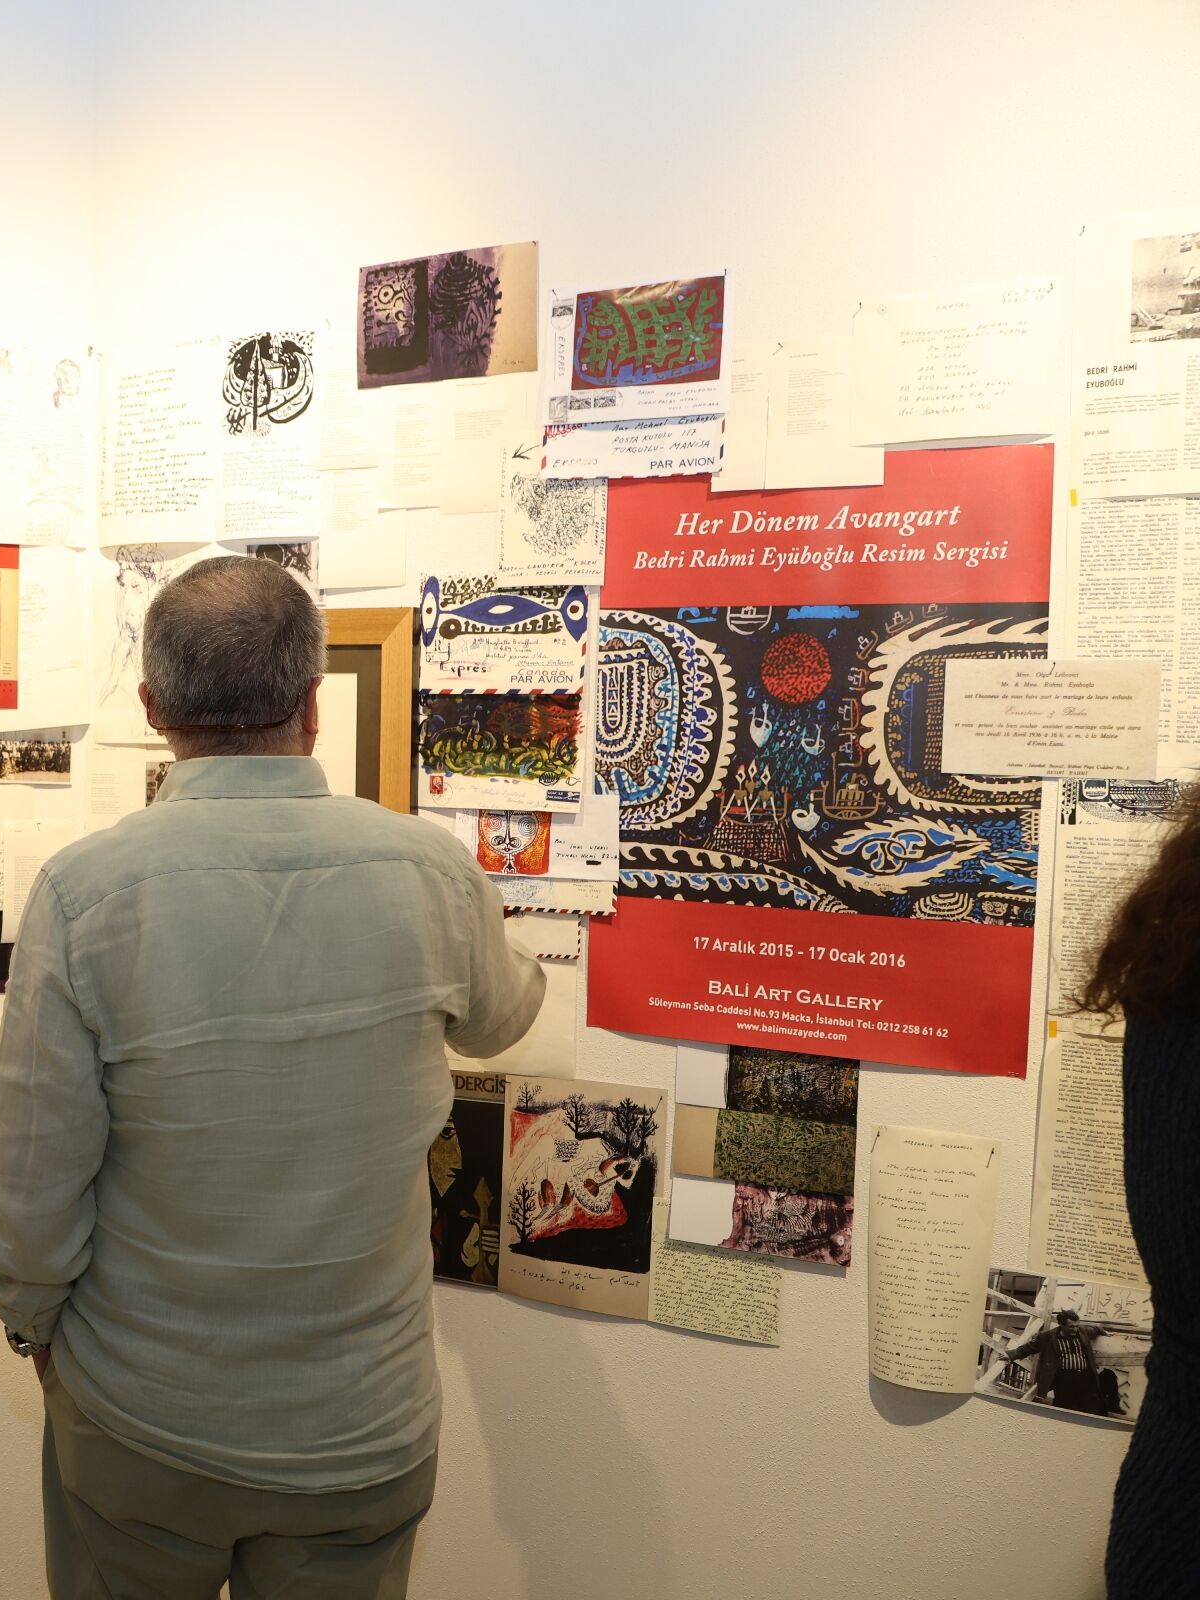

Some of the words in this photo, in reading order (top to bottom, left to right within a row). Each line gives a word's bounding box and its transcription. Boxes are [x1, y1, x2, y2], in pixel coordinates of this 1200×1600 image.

[649, 458, 673, 470] PAR
[678, 456, 716, 468] AVION
[673, 511, 723, 538] Her
[728, 507, 819, 535] Dönem
[824, 503, 962, 537] Avangart
[634, 549, 685, 571] Bedri
[689, 546, 755, 569] Rahmi
[759, 544, 855, 574] Eyüboğlu
[859, 541, 927, 564] Resim
[932, 538, 1010, 569] Sergisi
[510, 675, 533, 684] PAR
[538, 674, 574, 684] AVION
[692, 936, 711, 951] 17
[711, 936, 757, 956] Aralık
[758, 942, 795, 960] 2015
[807, 945, 826, 962] 17
[829, 946, 867, 966] Ocak
[869, 951, 907, 969] 2016
[753, 984, 793, 1003] ART
[795, 988, 885, 1013] GALLERY
[648, 995, 692, 1012] Süleyman
[693, 1001, 715, 1014] Seba
[716, 1002, 752, 1017] Caddesi
[753, 1006, 781, 1021] No.93
[815, 1011, 855, 1028] İstanbul
[856, 1018, 876, 1031] Tel:
[876, 1020, 901, 1033] 0212
[901, 1022, 921, 1035] 258
[922, 1024, 934, 1037] 61
[935, 1027, 949, 1039] 62
[735, 1020, 849, 1043] www.balimuzayede.com
